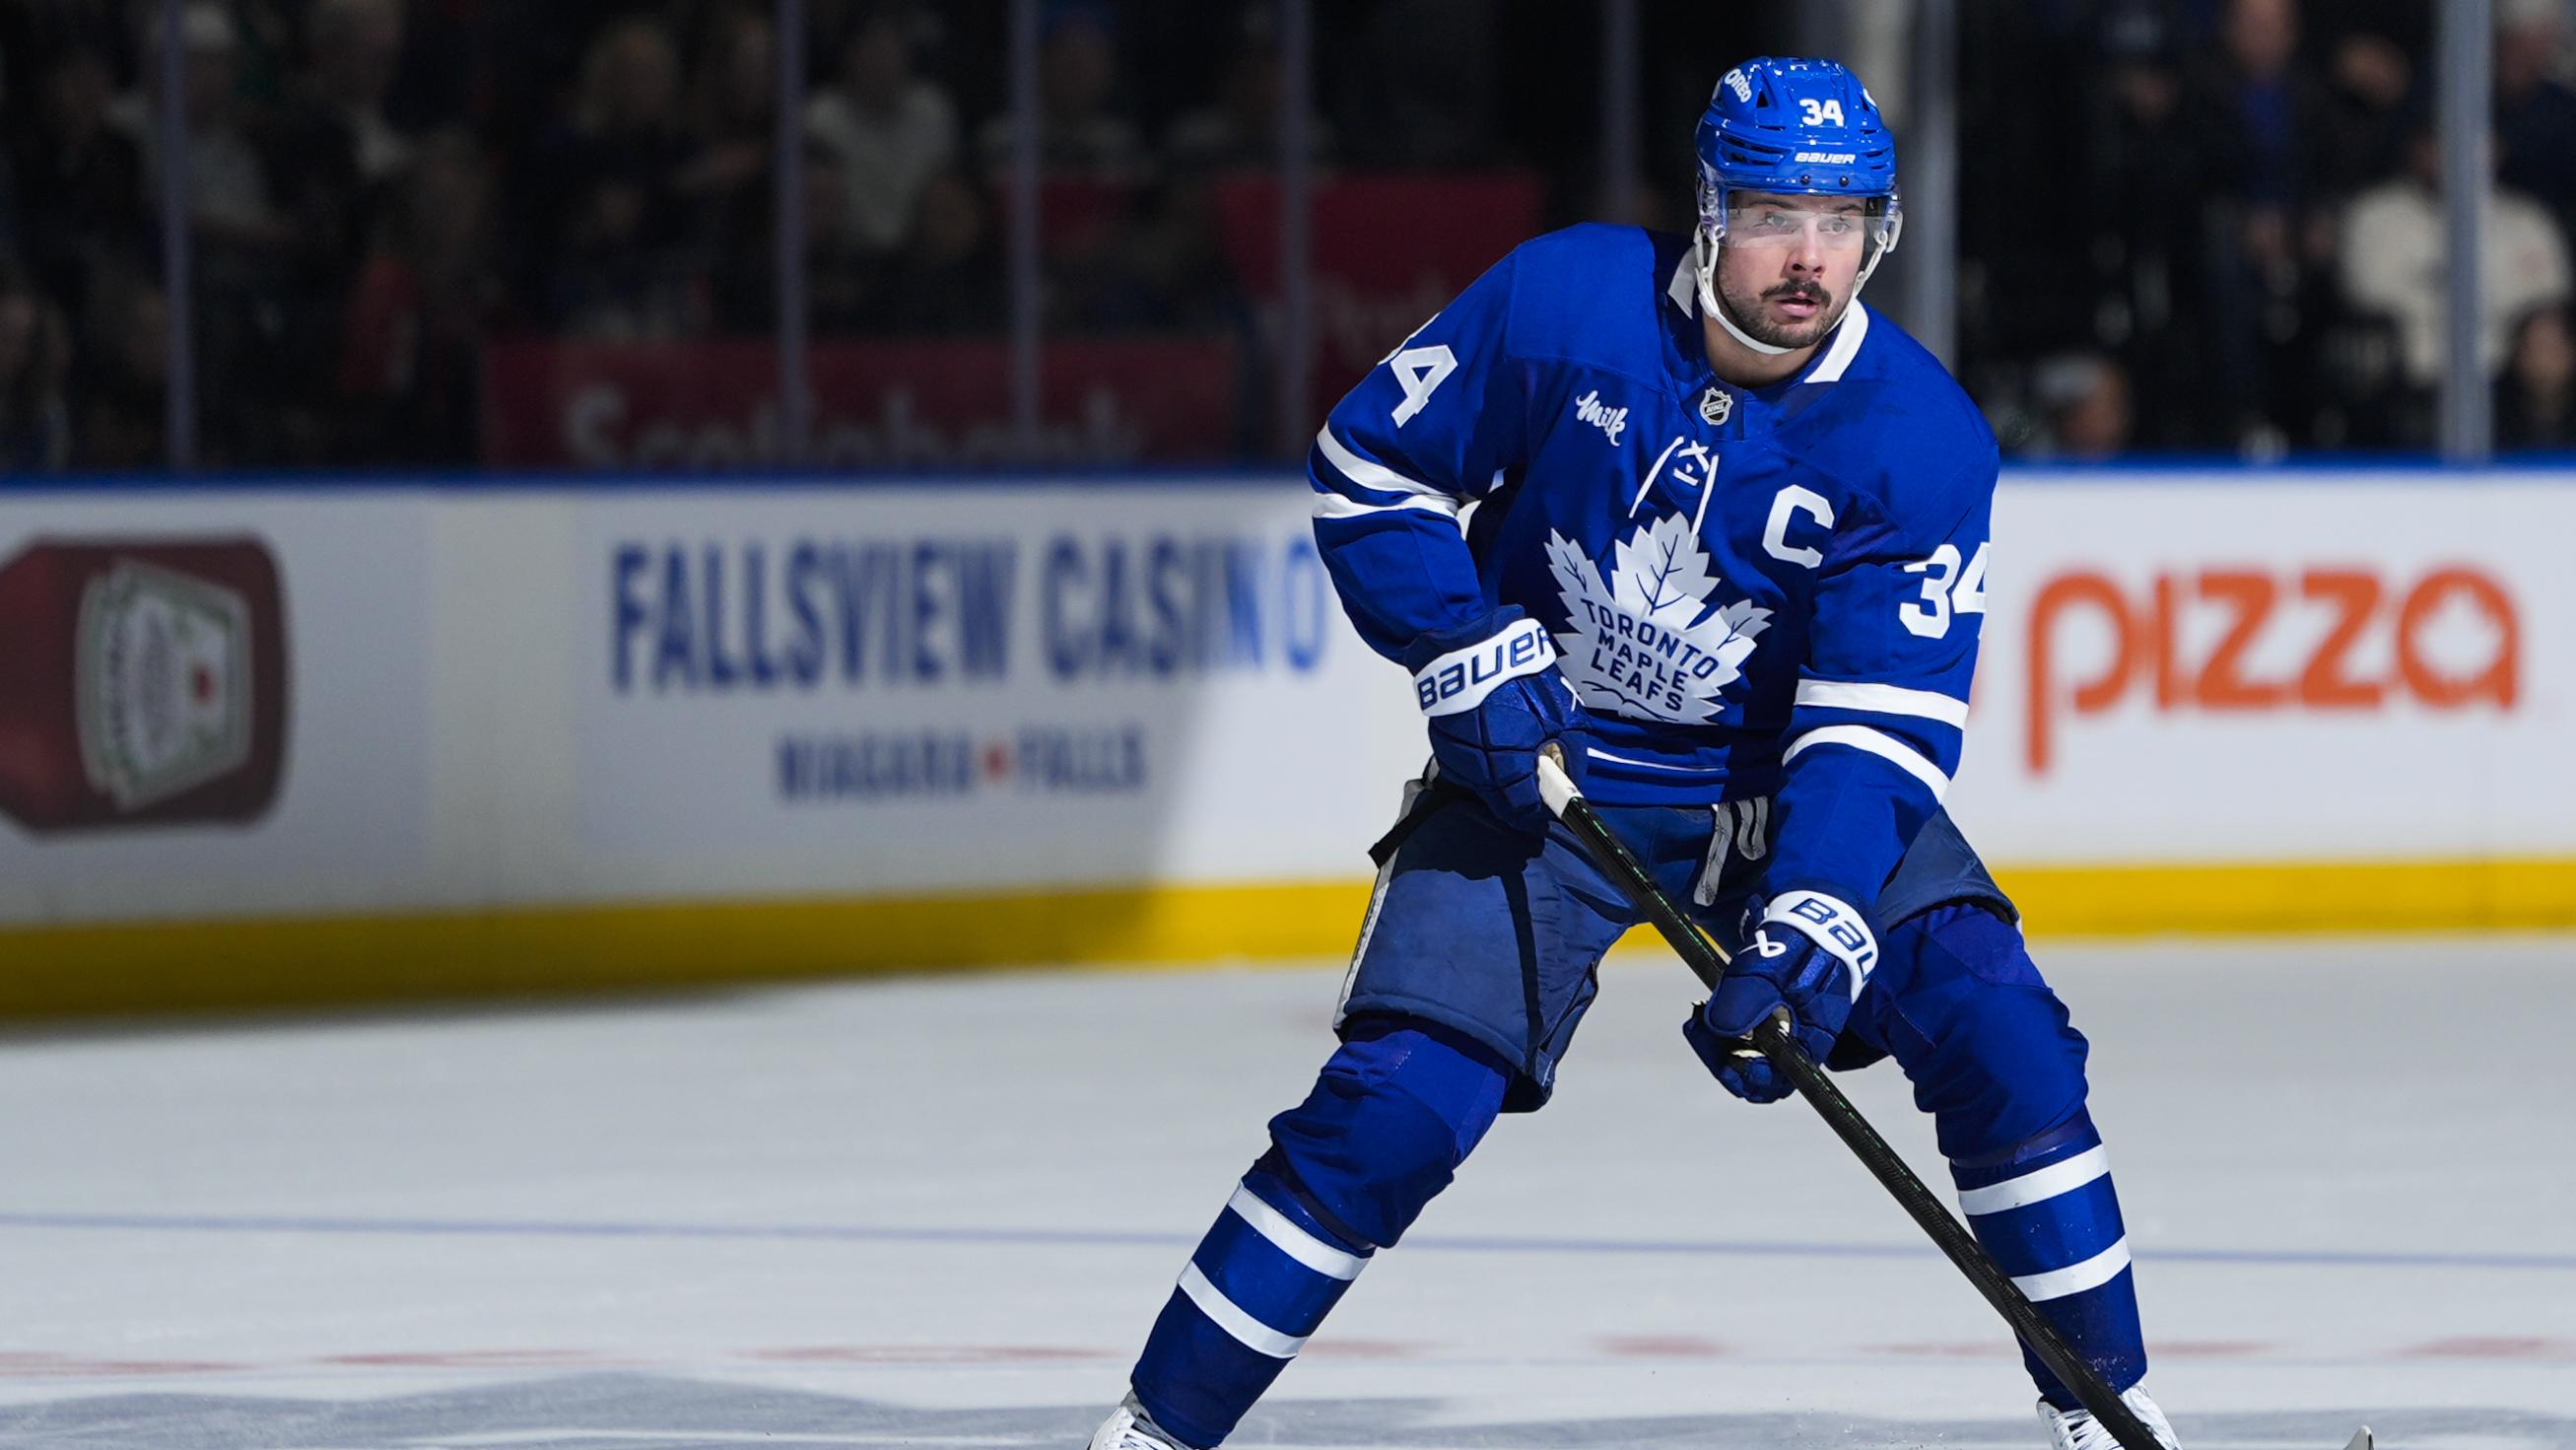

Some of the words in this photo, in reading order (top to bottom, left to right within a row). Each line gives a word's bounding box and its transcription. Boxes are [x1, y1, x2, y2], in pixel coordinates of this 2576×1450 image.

[1725, 68, 1752, 104] OREO
[1798, 99, 1845, 127] 34
[1795, 152, 1857, 165] BAUER
[1576, 390, 1629, 447] Milk
[1762, 484, 1835, 569] C
[612, 539, 1017, 693] FALLSVIEW
[1045, 536, 1326, 679] CASINO
[1581, 597, 1720, 679] TORONTO
[1591, 648, 1683, 712] LEAFS
[1598, 627, 1689, 692] MAPLE
